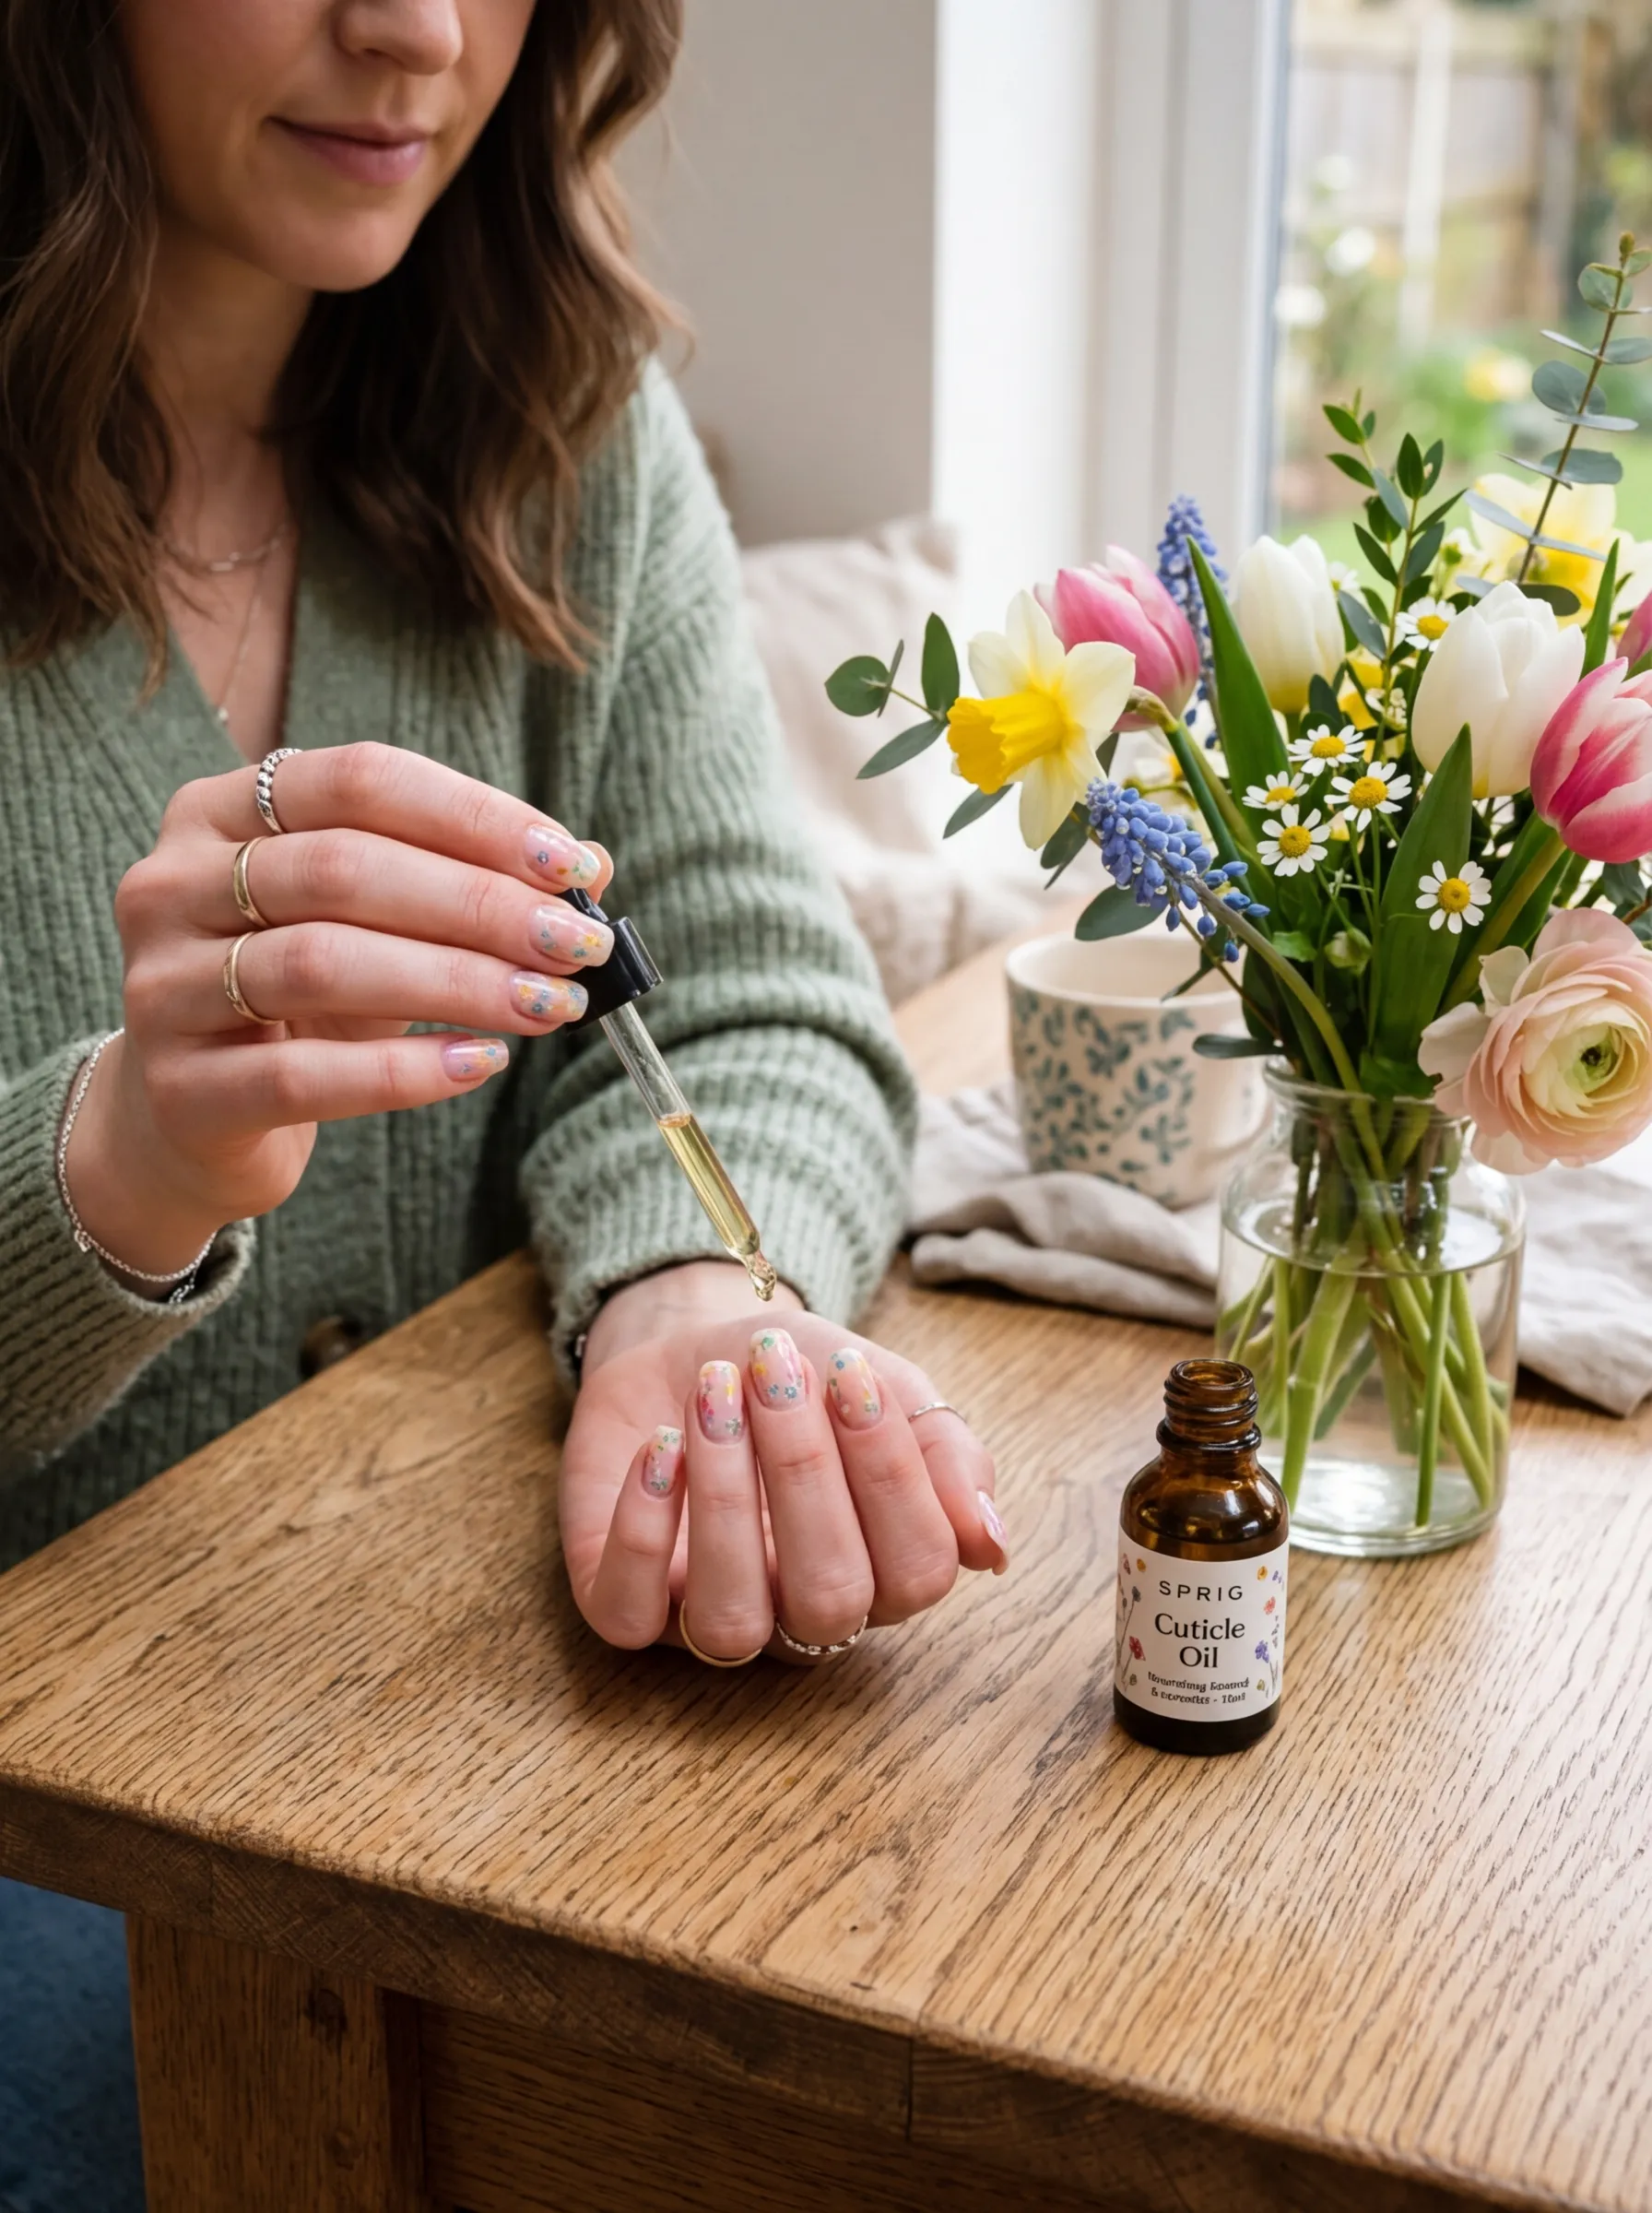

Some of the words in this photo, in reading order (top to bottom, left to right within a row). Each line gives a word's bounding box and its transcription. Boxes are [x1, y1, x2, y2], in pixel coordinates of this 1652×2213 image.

[1159, 1580, 1243, 1602] SPRIG
[1154, 1613, 1245, 1640] Cuticle
[1179, 1646, 1219, 1668] Oil
